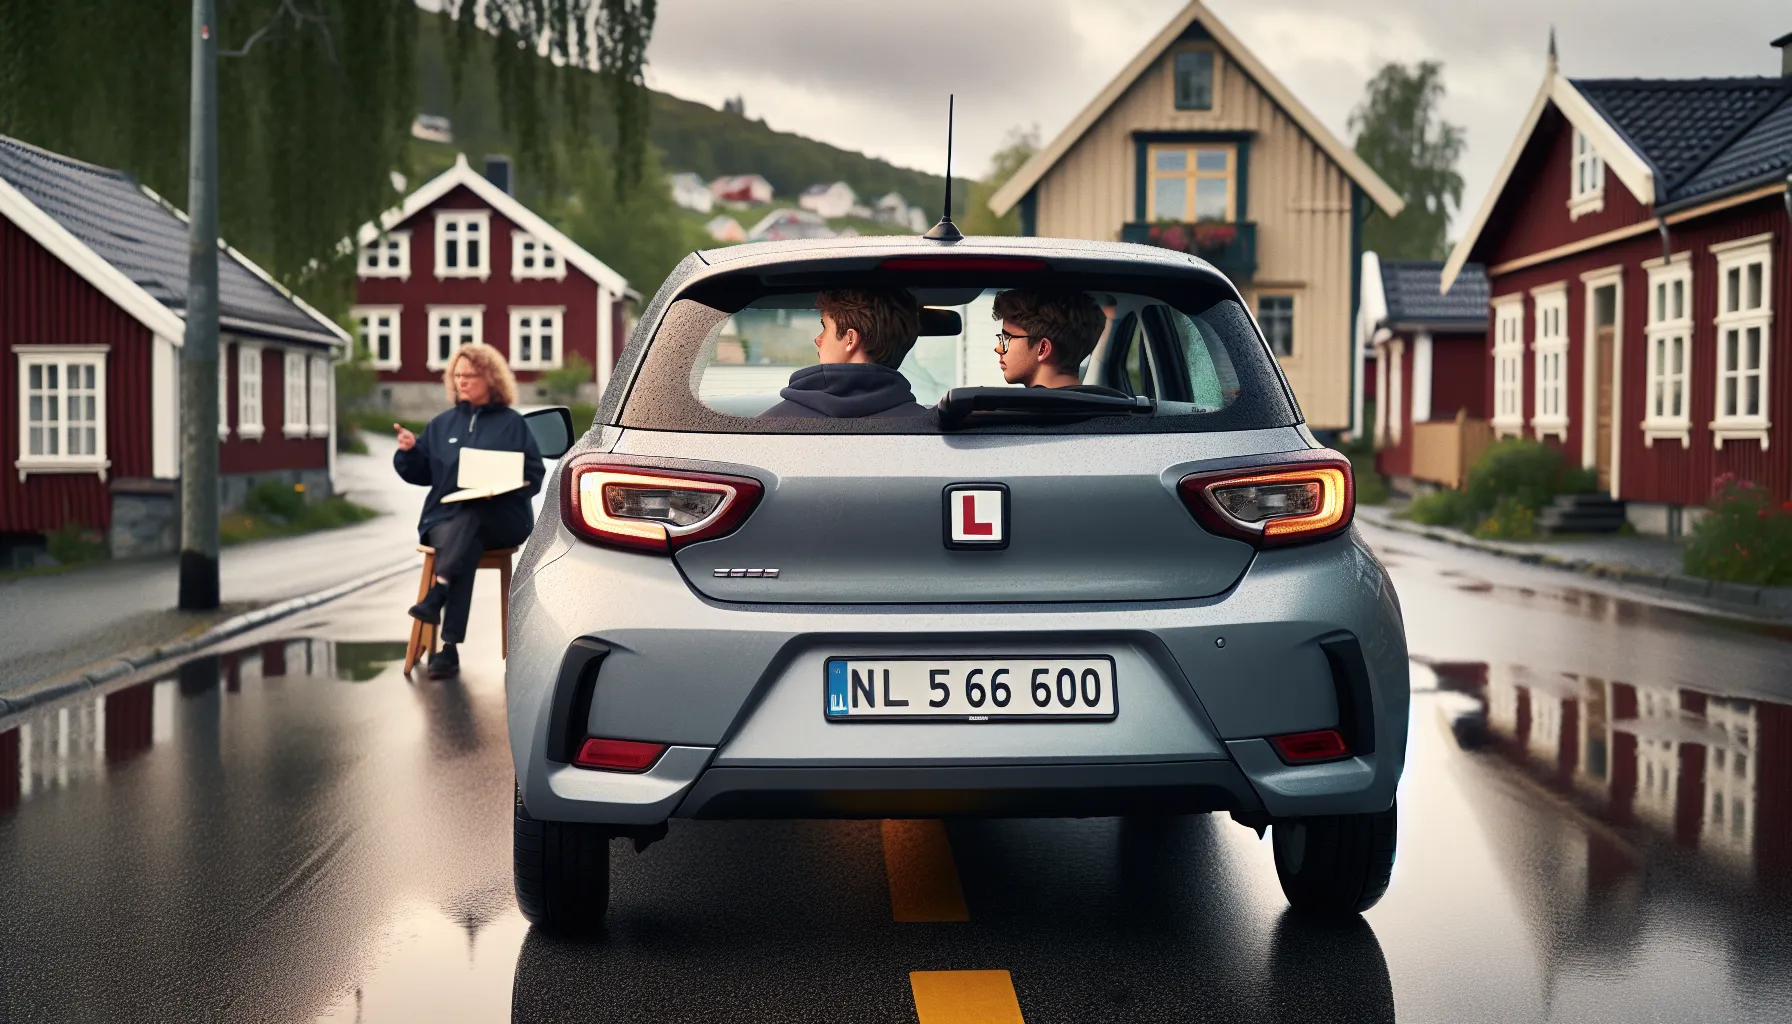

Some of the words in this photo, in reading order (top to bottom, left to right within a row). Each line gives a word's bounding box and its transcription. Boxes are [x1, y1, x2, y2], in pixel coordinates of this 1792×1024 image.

[962, 494, 993, 536] L
[851, 668, 910, 709] NL
[928, 668, 951, 708] 5
[965, 668, 1012, 709] 66
[1030, 667, 1101, 708] 600
